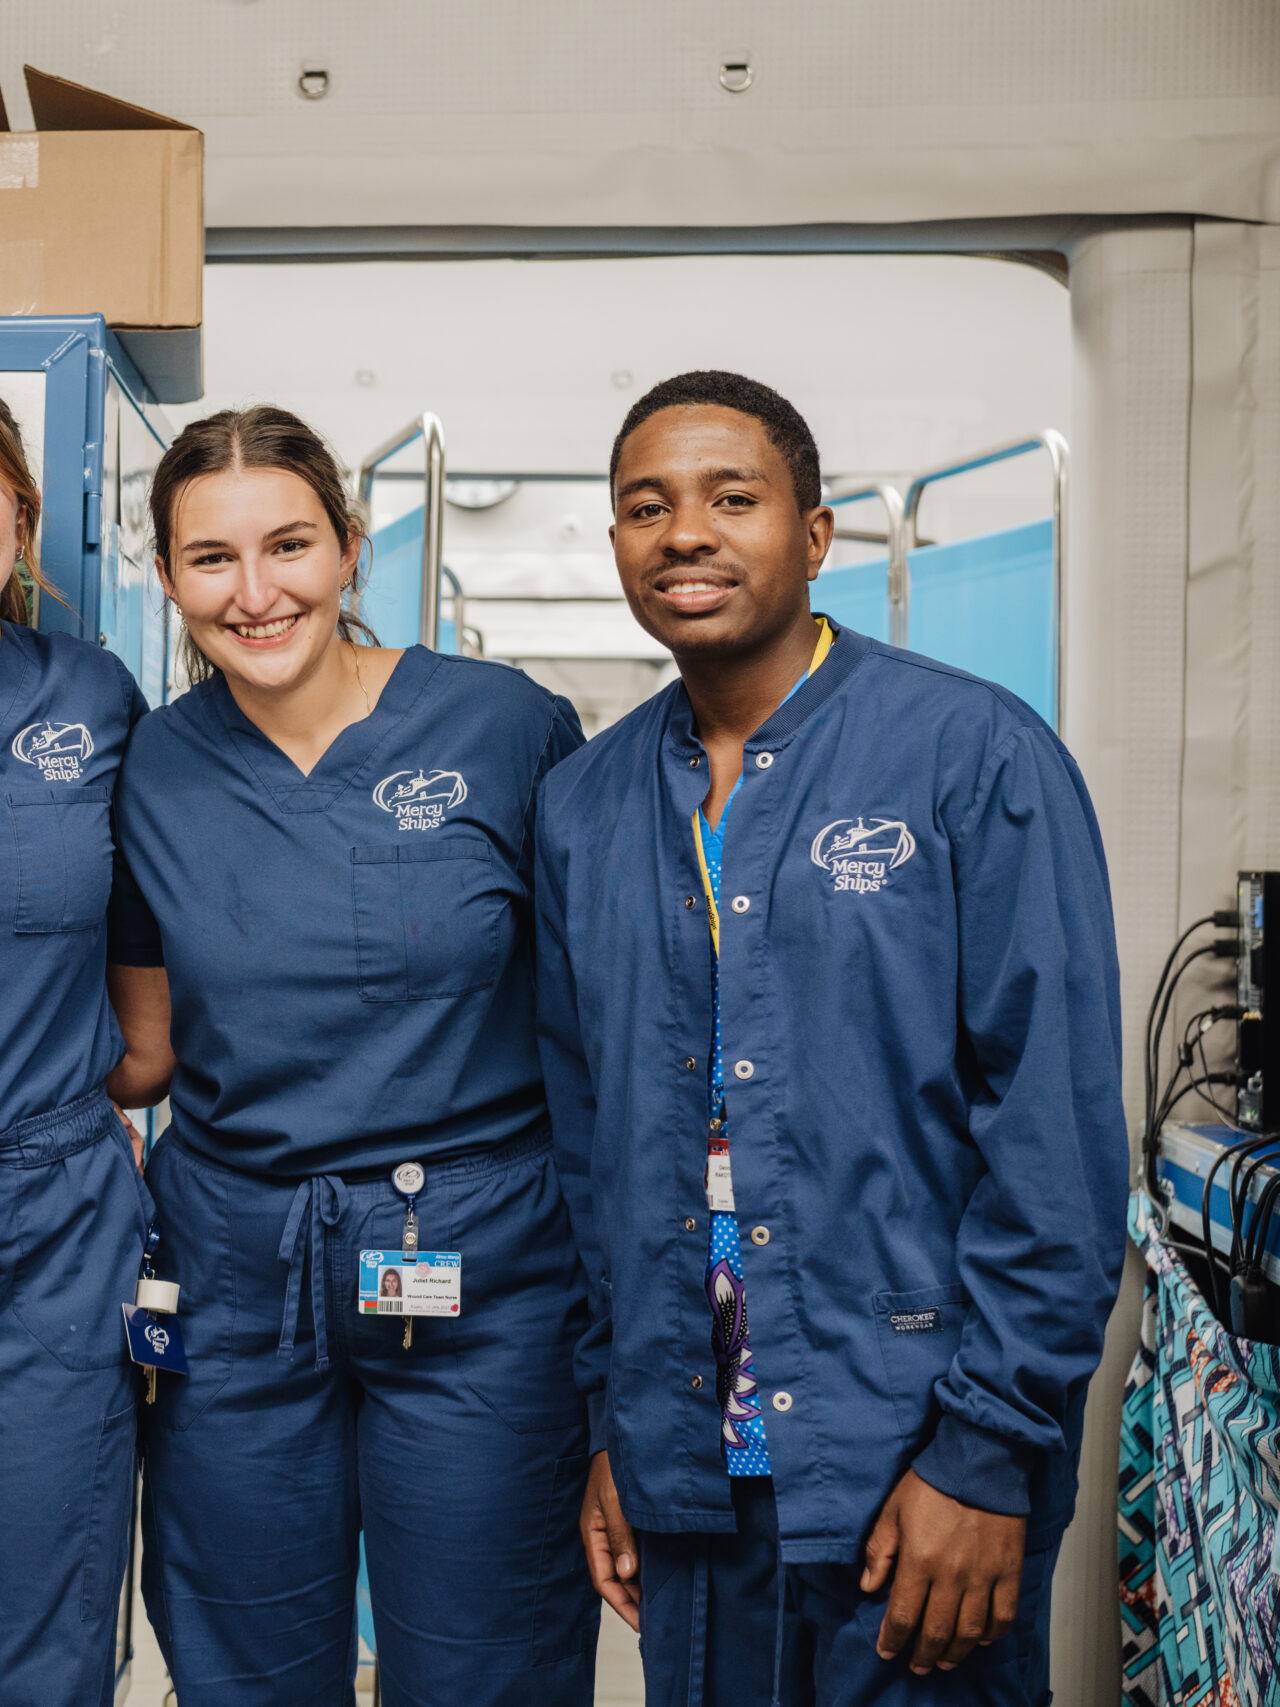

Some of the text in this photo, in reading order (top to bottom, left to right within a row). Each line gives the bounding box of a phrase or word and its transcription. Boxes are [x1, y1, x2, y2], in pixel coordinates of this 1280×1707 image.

[37, 755, 79, 770] Mercy
[43, 767, 81, 783] Ships
[394, 803, 443, 819] Mercy
[398, 815, 441, 831] Ships
[829, 859, 886, 879] Mercy
[833, 873, 882, 895] Ships
[434, 1260, 459, 1268] CREW
[890, 1312, 936, 1324] CHEROKEE
[895, 1322, 934, 1331] WORKWEAR
